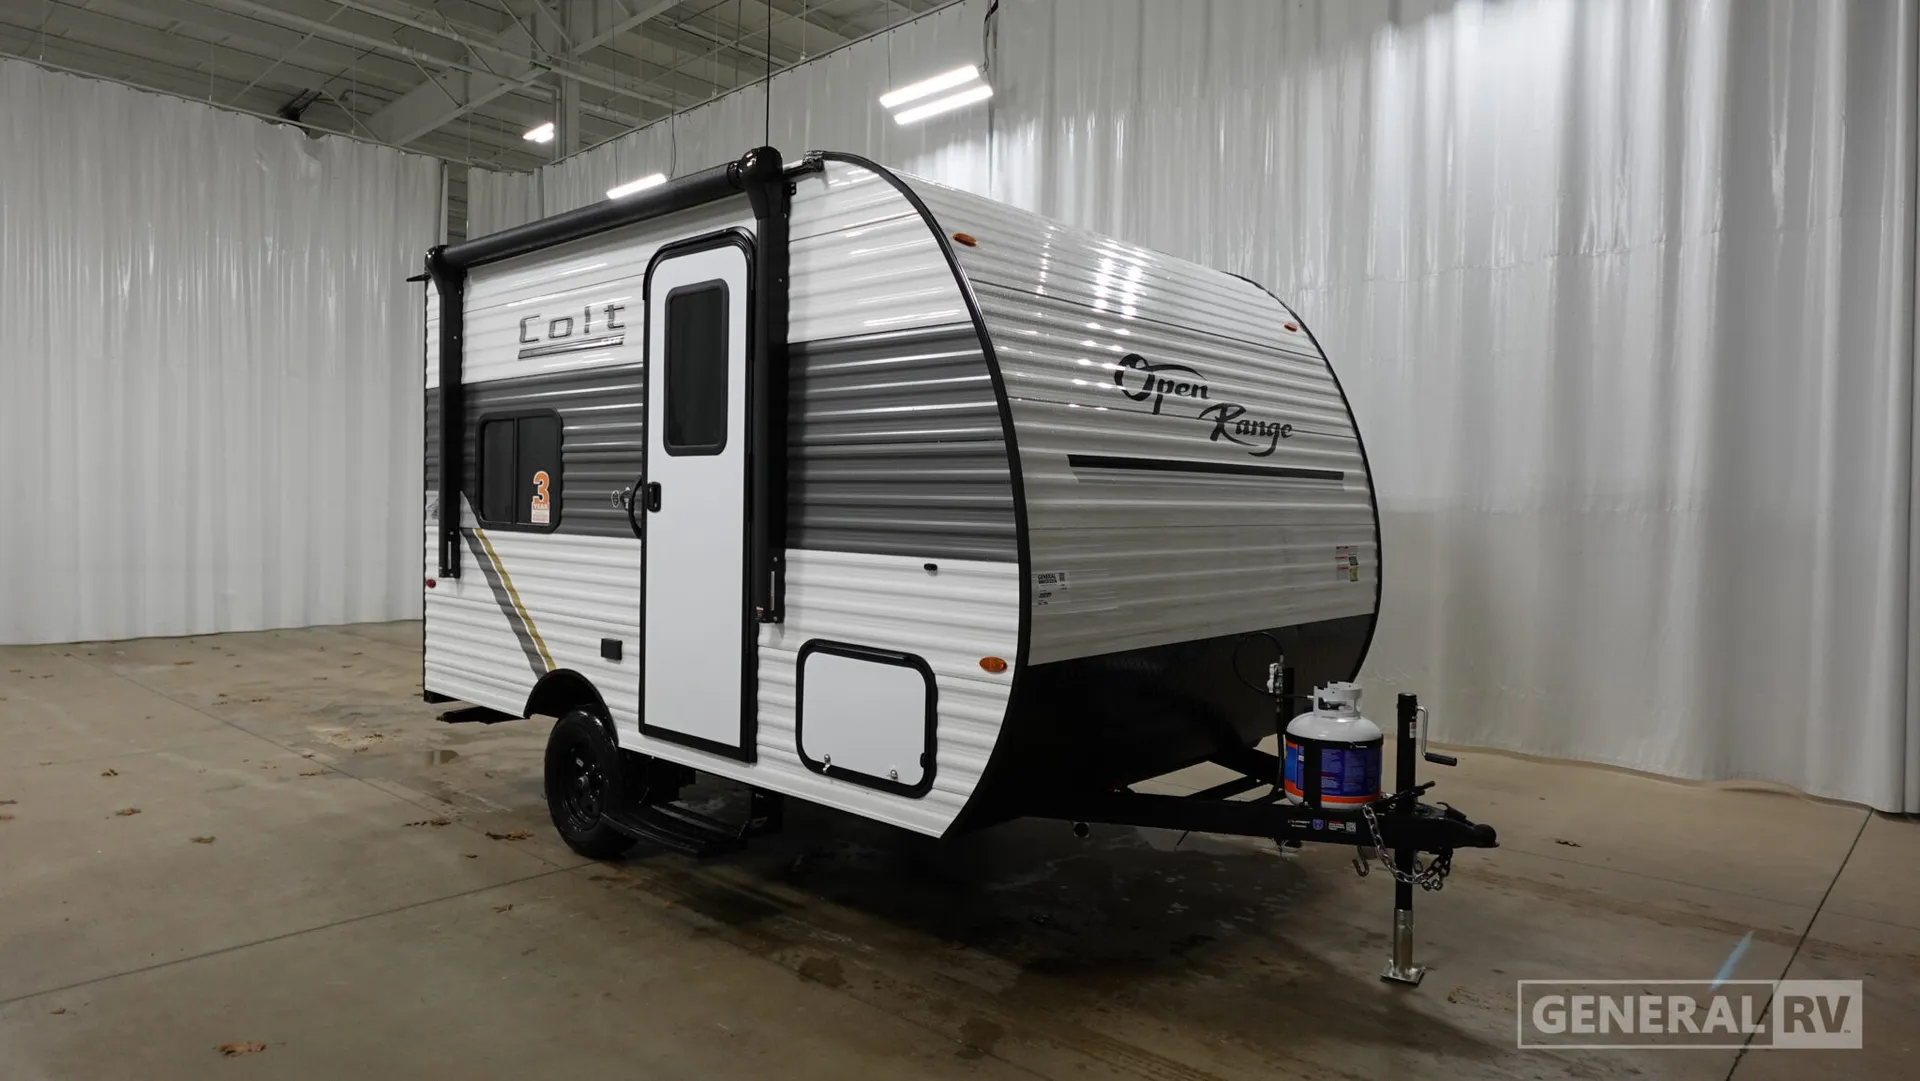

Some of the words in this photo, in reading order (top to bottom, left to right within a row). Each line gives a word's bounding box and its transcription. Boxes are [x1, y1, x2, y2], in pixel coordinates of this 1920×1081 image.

[519, 304, 625, 343] Colt
[1113, 353, 1211, 415] Open
[1197, 402, 1293, 457] Range
[533, 470, 550, 504] 3
